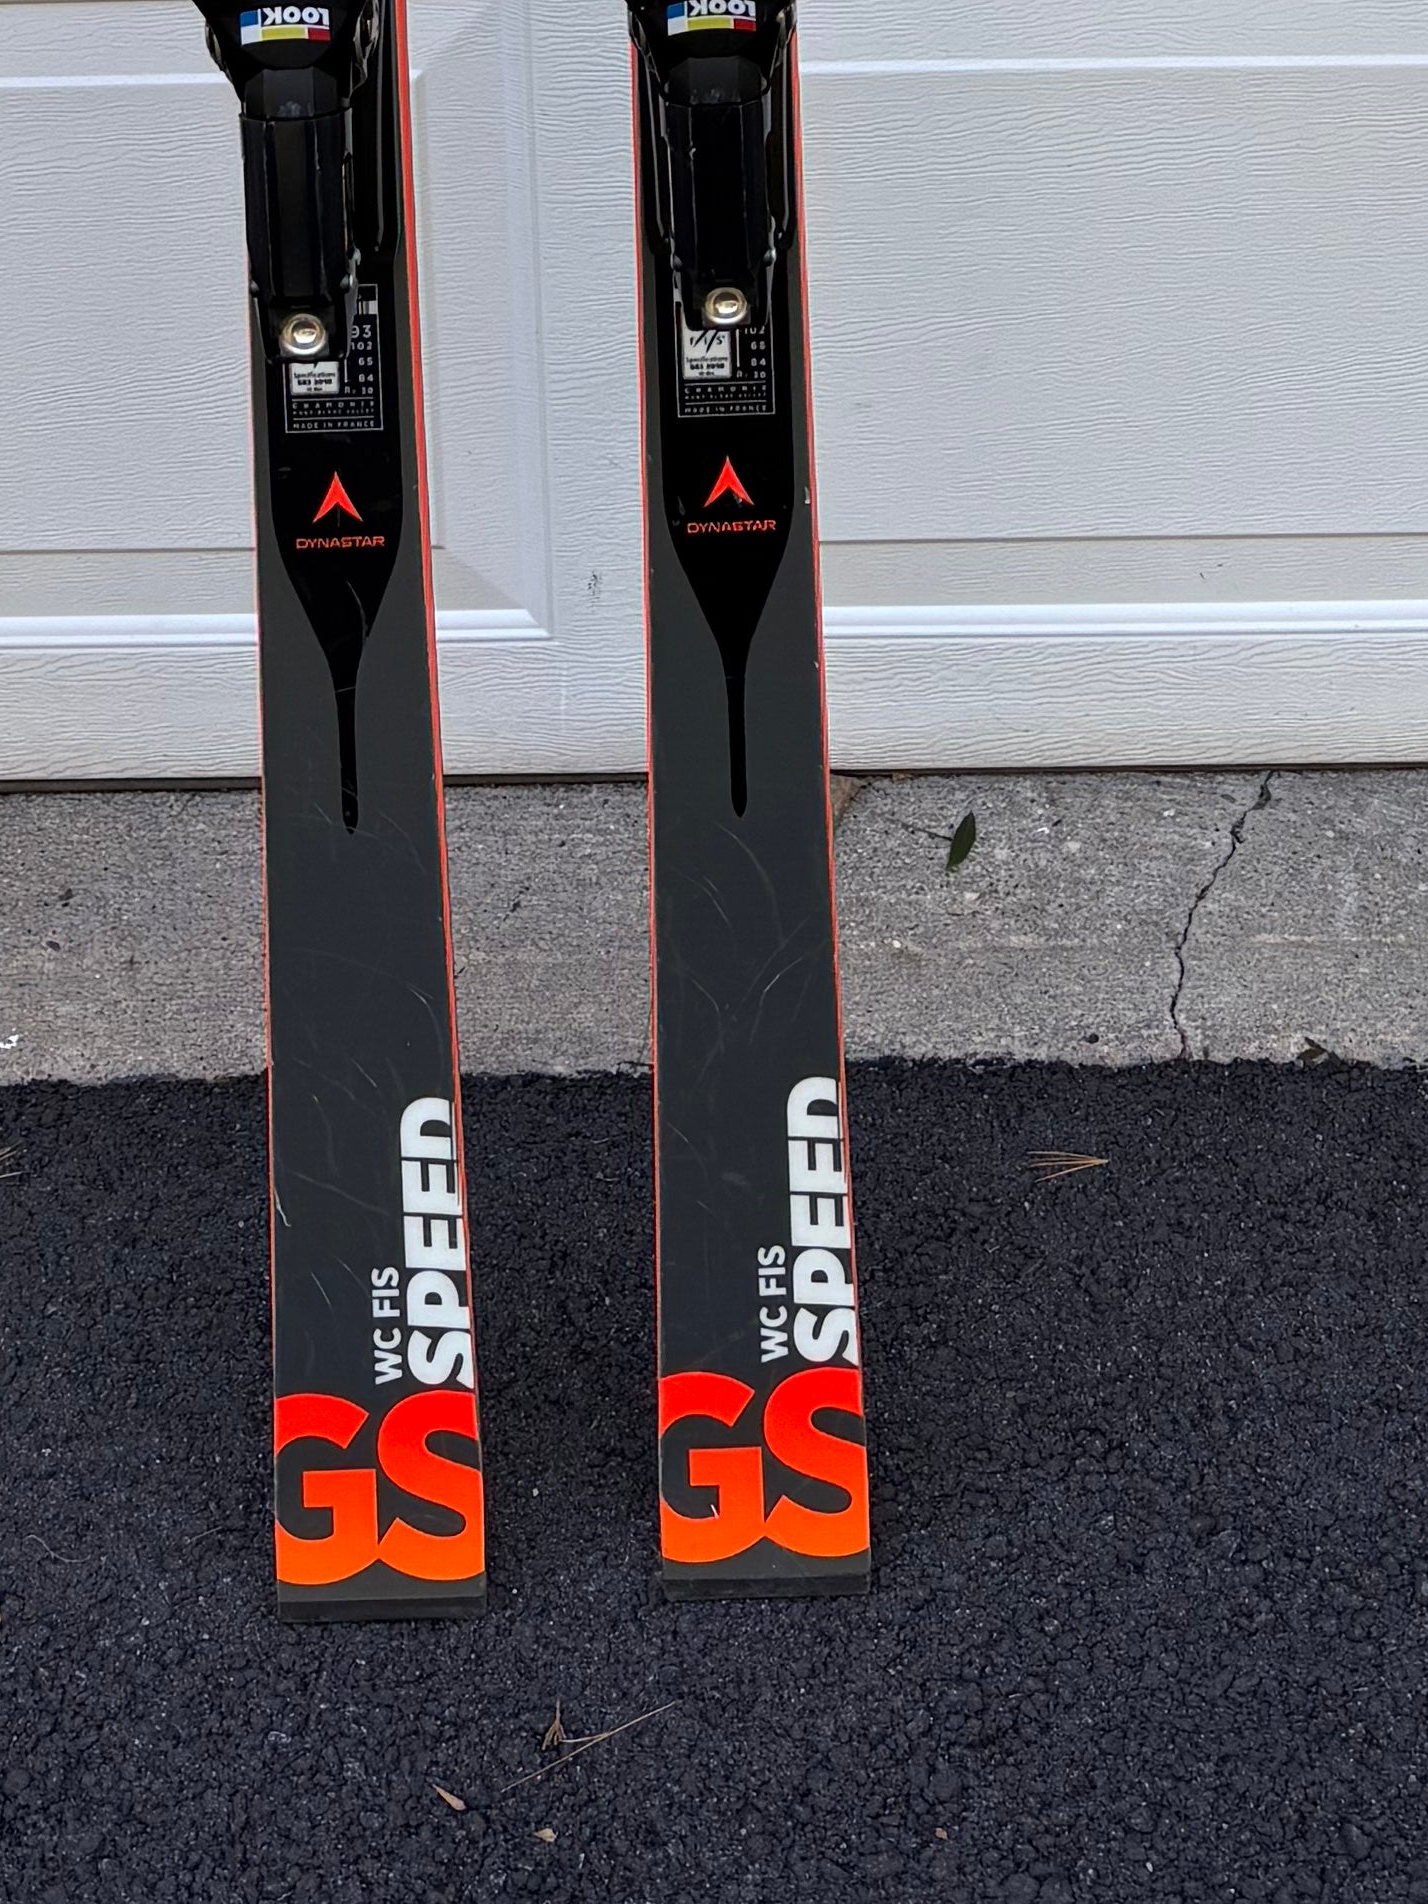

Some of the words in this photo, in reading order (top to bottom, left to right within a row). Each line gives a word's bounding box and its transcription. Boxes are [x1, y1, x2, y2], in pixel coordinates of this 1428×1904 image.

[262, 5, 330, 26] LOOK
[358, 356, 374, 367] 65
[293, 421, 319, 430] MADE
[296, 535, 385, 549] DYNASTAR
[687, 519, 776, 534] DYNASTAR
[400, 1097, 474, 1389] SPEED
[787, 1076, 859, 1366] SPEED
[371, 1266, 400, 1318] FIS
[757, 1245, 787, 1297] FIS
[373, 1326, 403, 1385] WC
[759, 1305, 789, 1363] WC
[274, 1390, 485, 1585] GS
[658, 1366, 870, 1563] GS
